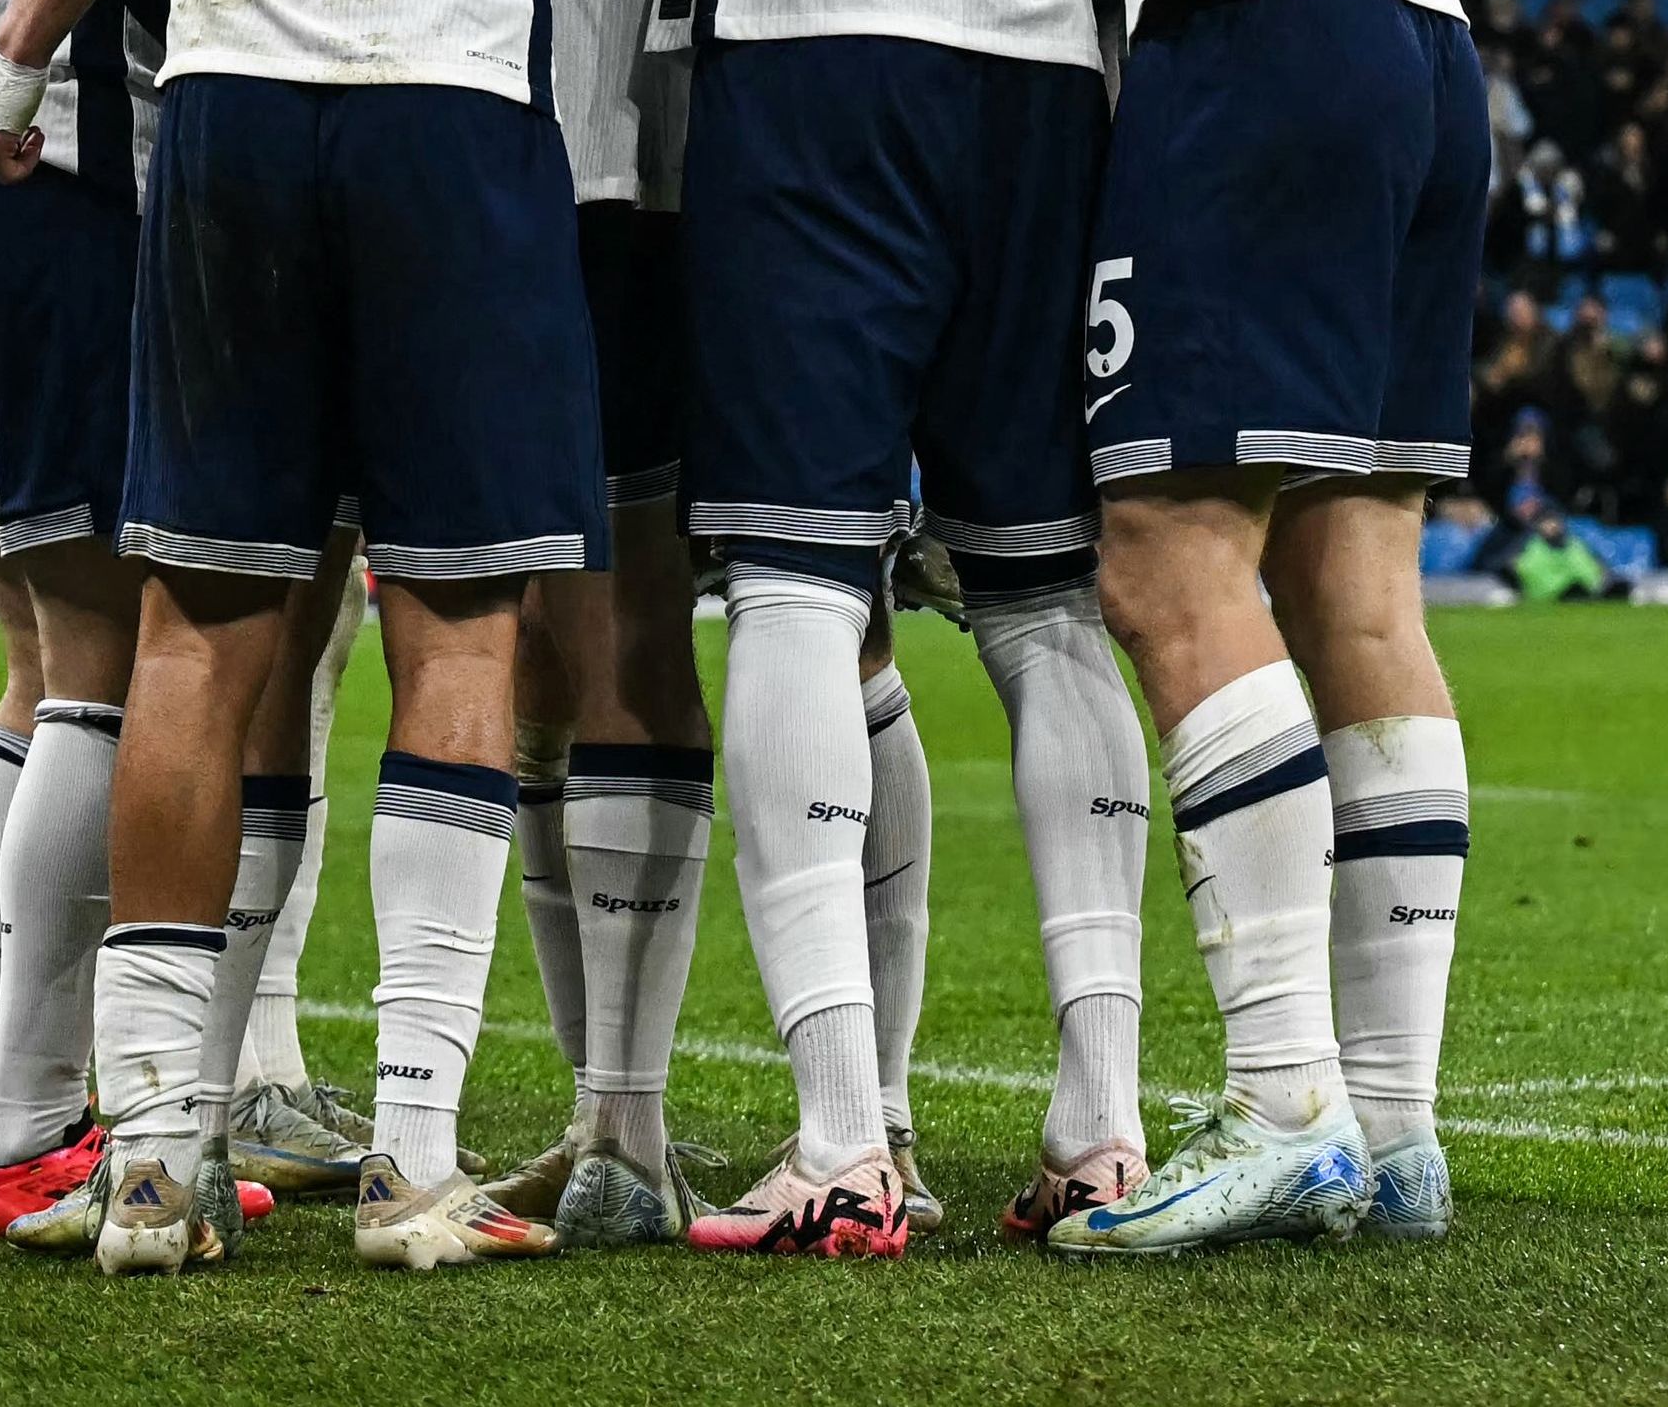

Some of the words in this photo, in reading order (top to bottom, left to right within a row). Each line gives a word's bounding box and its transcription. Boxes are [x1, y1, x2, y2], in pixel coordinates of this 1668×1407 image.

[1086, 257, 1135, 378] 5
[807, 801, 871, 826] Spurs
[592, 892, 680, 914] Spurs
[226, 911, 280, 930] Spu
[1390, 905, 1456, 925] Spurs
